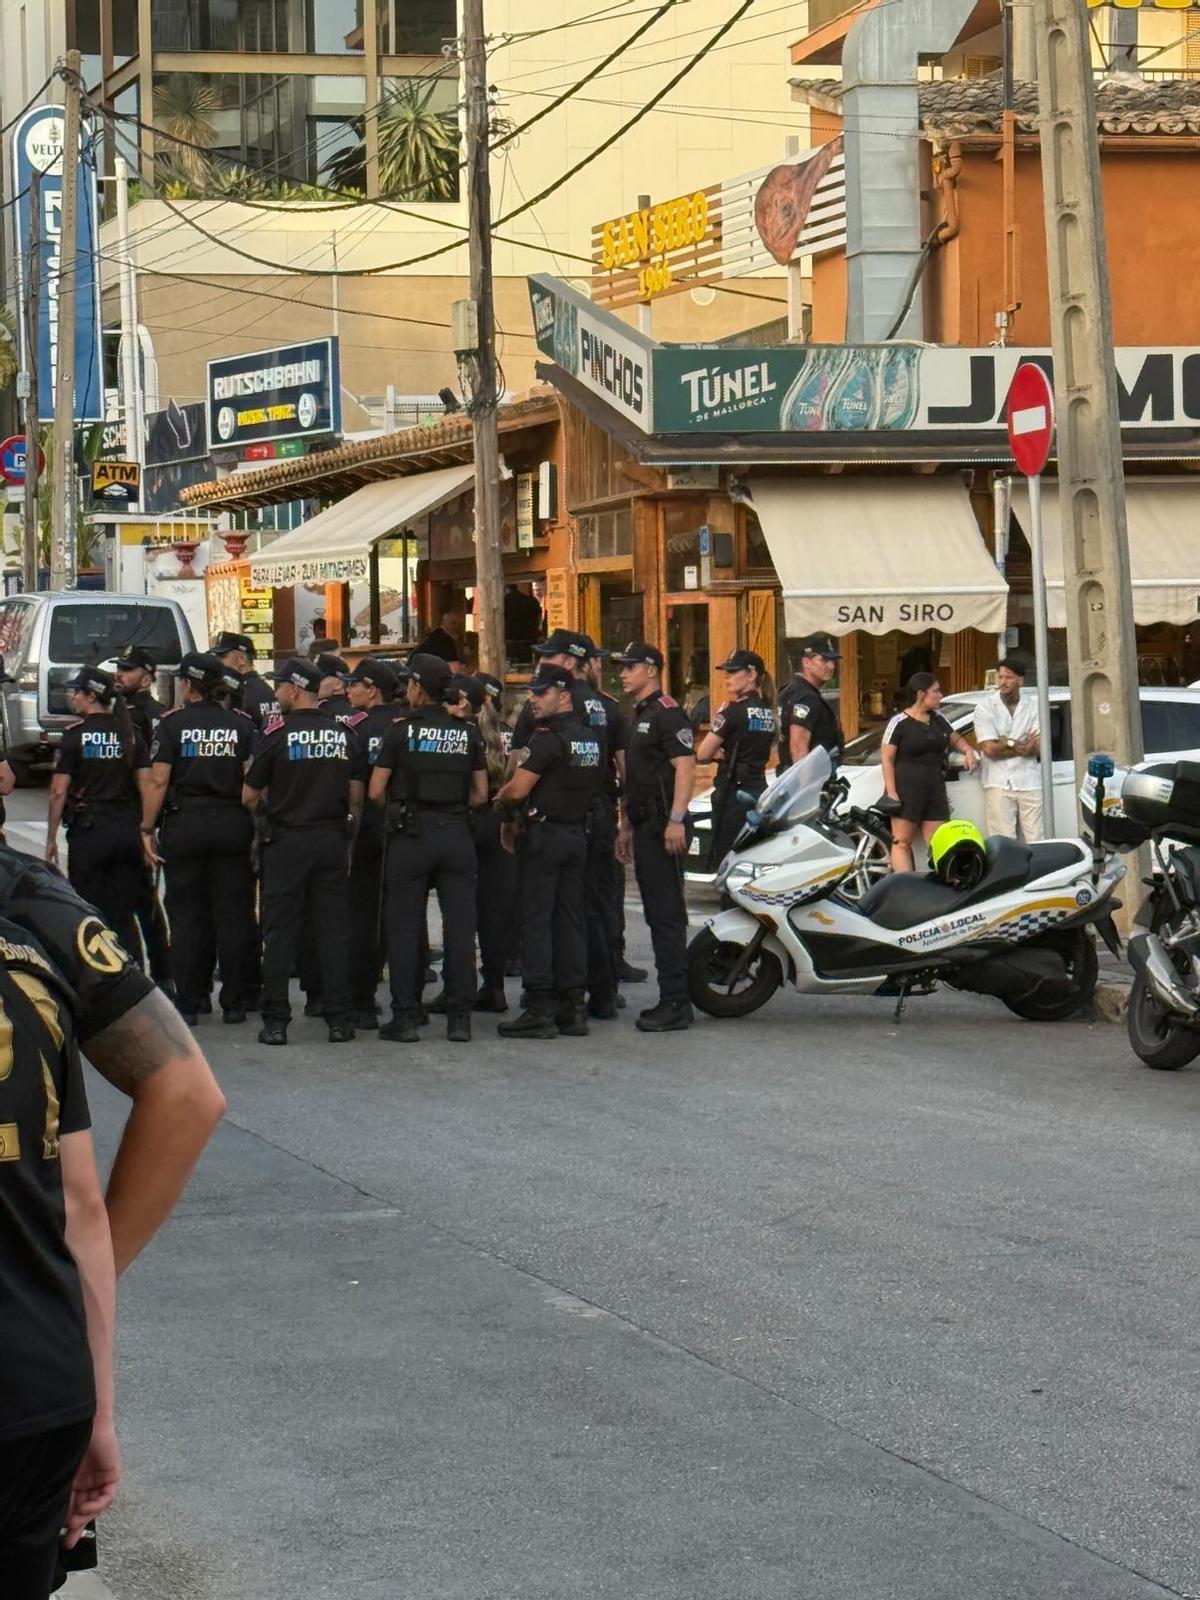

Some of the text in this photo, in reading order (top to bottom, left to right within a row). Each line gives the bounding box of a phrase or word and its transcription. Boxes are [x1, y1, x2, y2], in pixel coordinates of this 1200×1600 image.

[602, 191, 708, 269] SAN SIRO
[214, 359, 320, 400] RUTSCHBAHN
[580, 327, 643, 415] PINCHOS
[681, 362, 777, 413] TÚNEL
[713, 397, 767, 418] MALLORCA
[96, 464, 137, 480] ATM
[838, 603, 954, 623] SAN SIRO
[181, 728, 238, 743] POLICIA
[287, 729, 347, 746] POLICIA
[419, 727, 468, 742] POLICIA
[200, 743, 236, 757] LOCAL
[307, 744, 348, 760] LOCAL
[436, 740, 468, 755] LOCAL
[898, 912, 986, 946] POLICIA LOCAL
